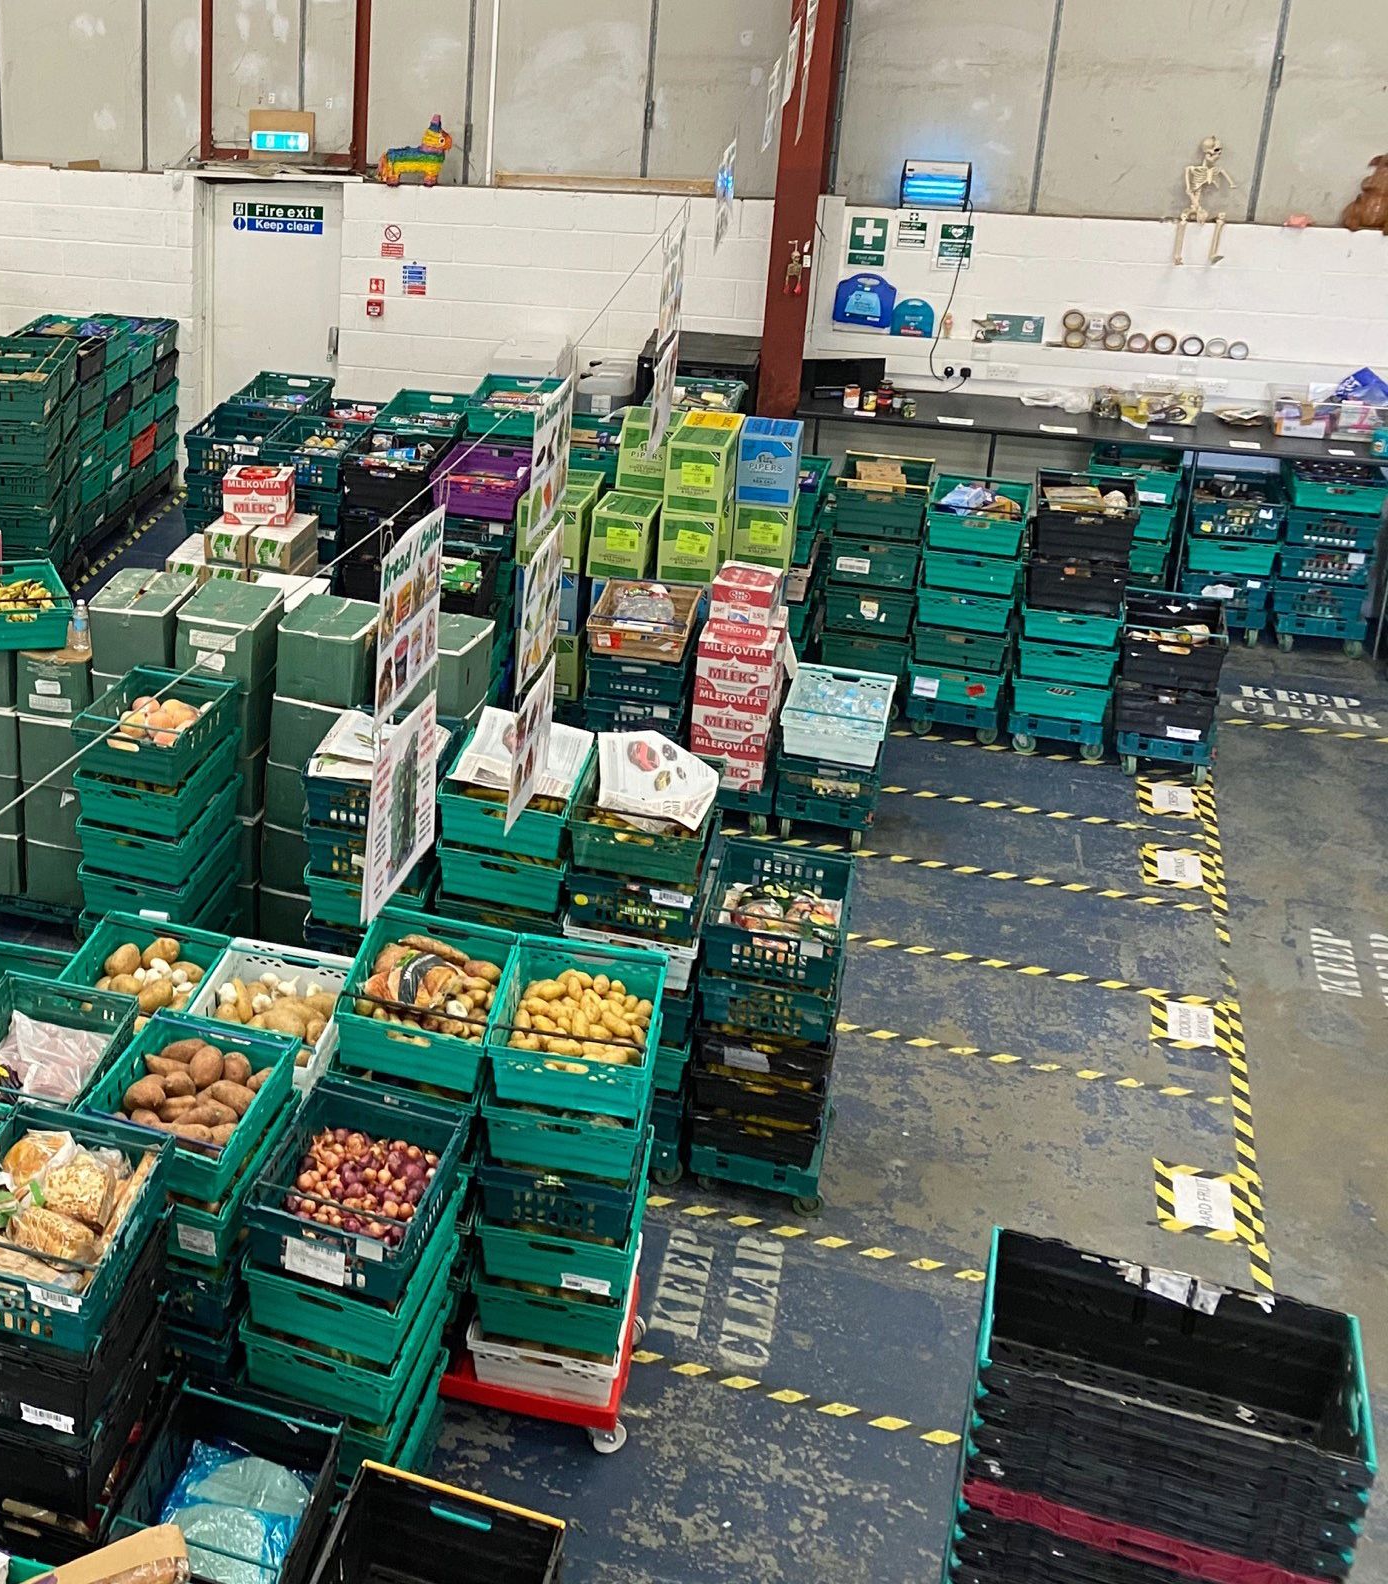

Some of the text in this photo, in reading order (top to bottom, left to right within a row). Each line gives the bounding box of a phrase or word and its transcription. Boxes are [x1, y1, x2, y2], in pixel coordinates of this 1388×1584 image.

[255, 205, 316, 219] Fire exit
[255, 219, 315, 232] Keep clear
[630, 450, 663, 461] PIPRS
[749, 463, 783, 472] PIPERS
[227, 480, 281, 489] MLEKOVITA
[233, 503, 276, 513] MLEKO
[383, 547, 412, 592] Bread
[712, 623, 762, 637] MLEKOVITA
[704, 643, 767, 658] MLEKOVITA
[708, 667, 759, 684] MLEKO
[699, 688, 762, 707] MLEKOVITA
[1239, 685, 1361, 709] KEEP
[1231, 700, 1382, 729] CLEAR
[703, 715, 754, 732] MLEKO
[695, 737, 757, 754] MLEKOVITA
[1310, 927, 1363, 998] KEEP
[649, 1228, 714, 1340] KEEP
[717, 1237, 785, 1367] CLEAR
